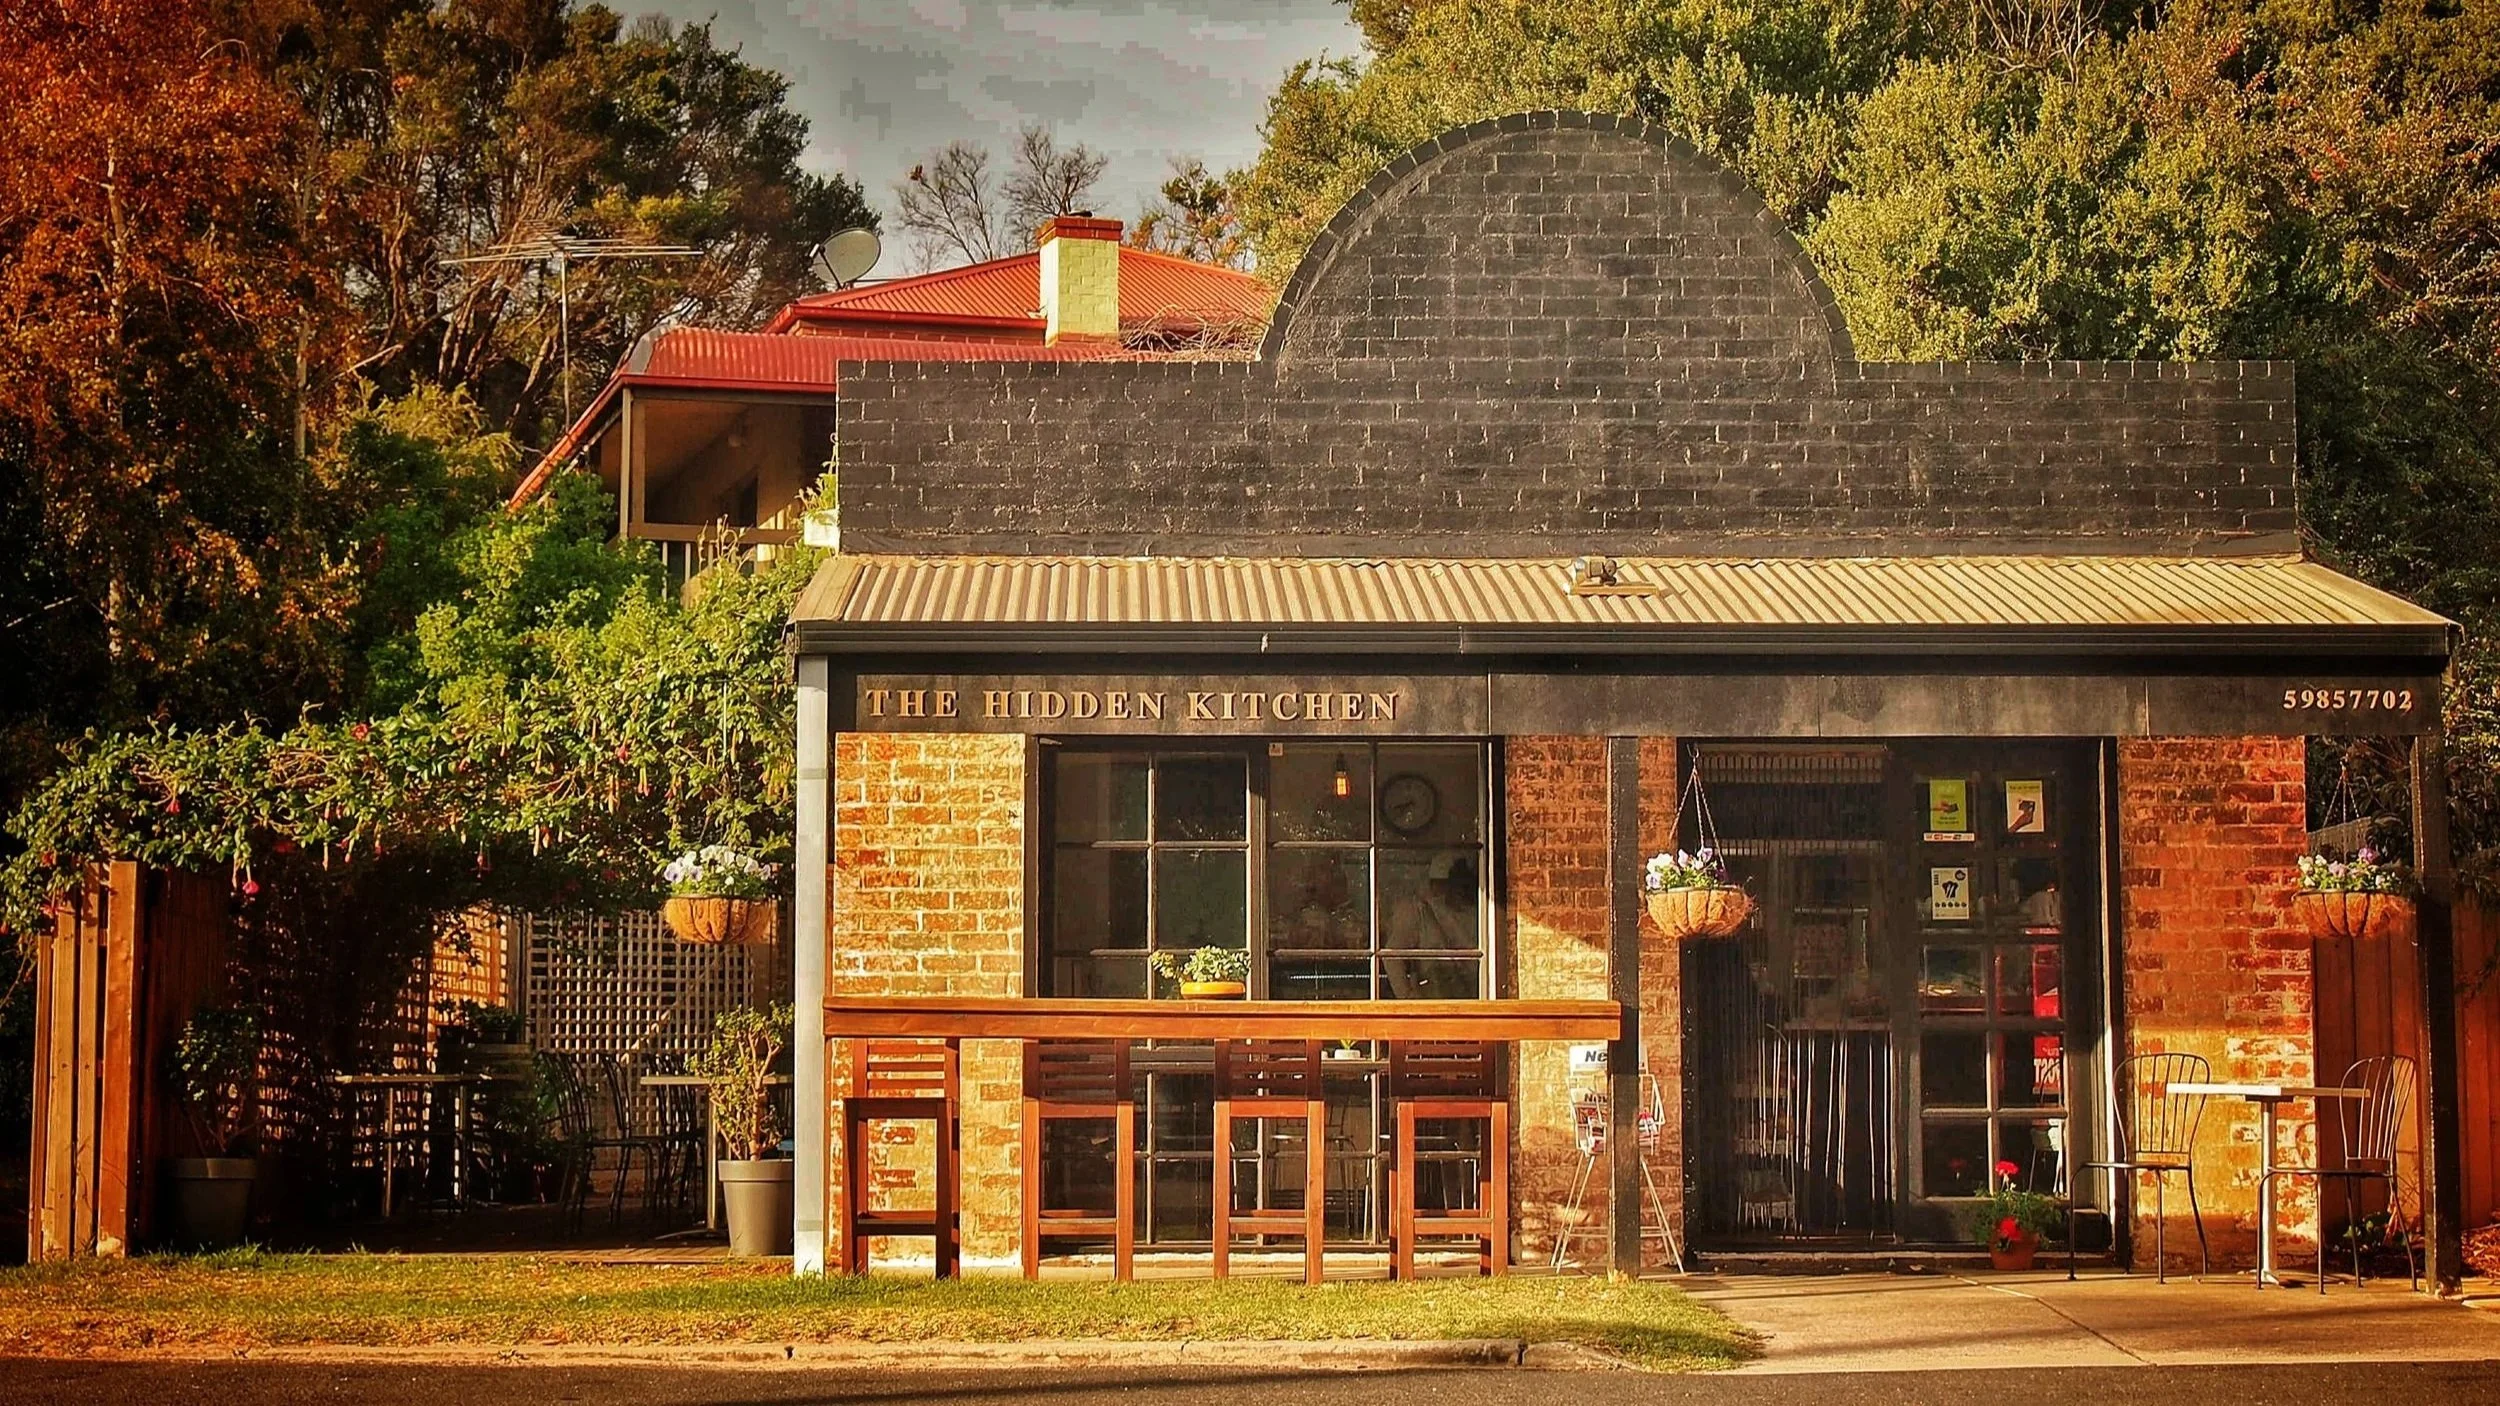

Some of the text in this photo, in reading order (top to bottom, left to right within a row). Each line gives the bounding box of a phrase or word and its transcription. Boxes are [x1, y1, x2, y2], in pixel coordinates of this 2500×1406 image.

[866, 689, 1399, 721] THE HIDDEN KITCHEN
[2283, 689, 2413, 713] 59857702
